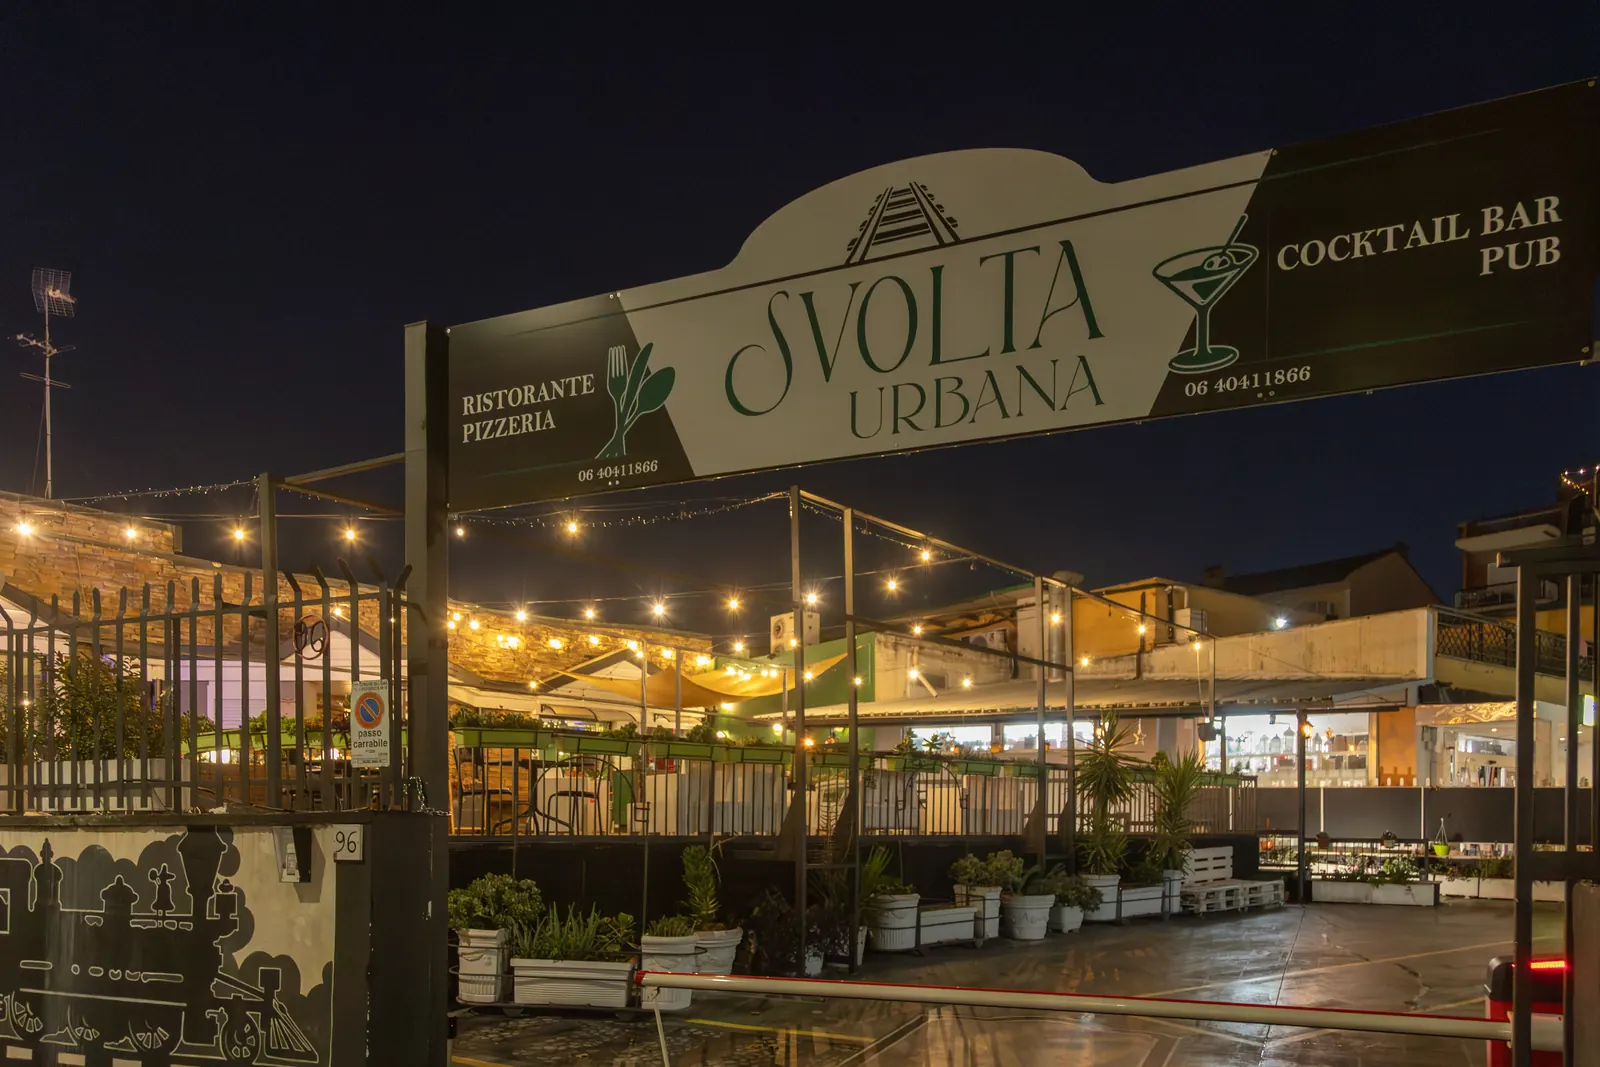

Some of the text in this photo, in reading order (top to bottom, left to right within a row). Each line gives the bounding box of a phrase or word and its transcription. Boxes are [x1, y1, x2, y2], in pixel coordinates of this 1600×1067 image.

[1276, 194, 1563, 272] COCKTAIL BAR
[1479, 236, 1562, 277] PUB
[724, 239, 1106, 417] SVOLTA
[462, 373, 595, 416] RISTORANTE
[849, 355, 1106, 440] URBANA
[1184, 365, 1312, 397] 06 40411866
[462, 409, 557, 444] PIZZERIA
[578, 459, 659, 482] 06 40411866
[353, 739, 388, 748] carrabile
[357, 729, 382, 739] passo
[335, 830, 358, 853] 96
